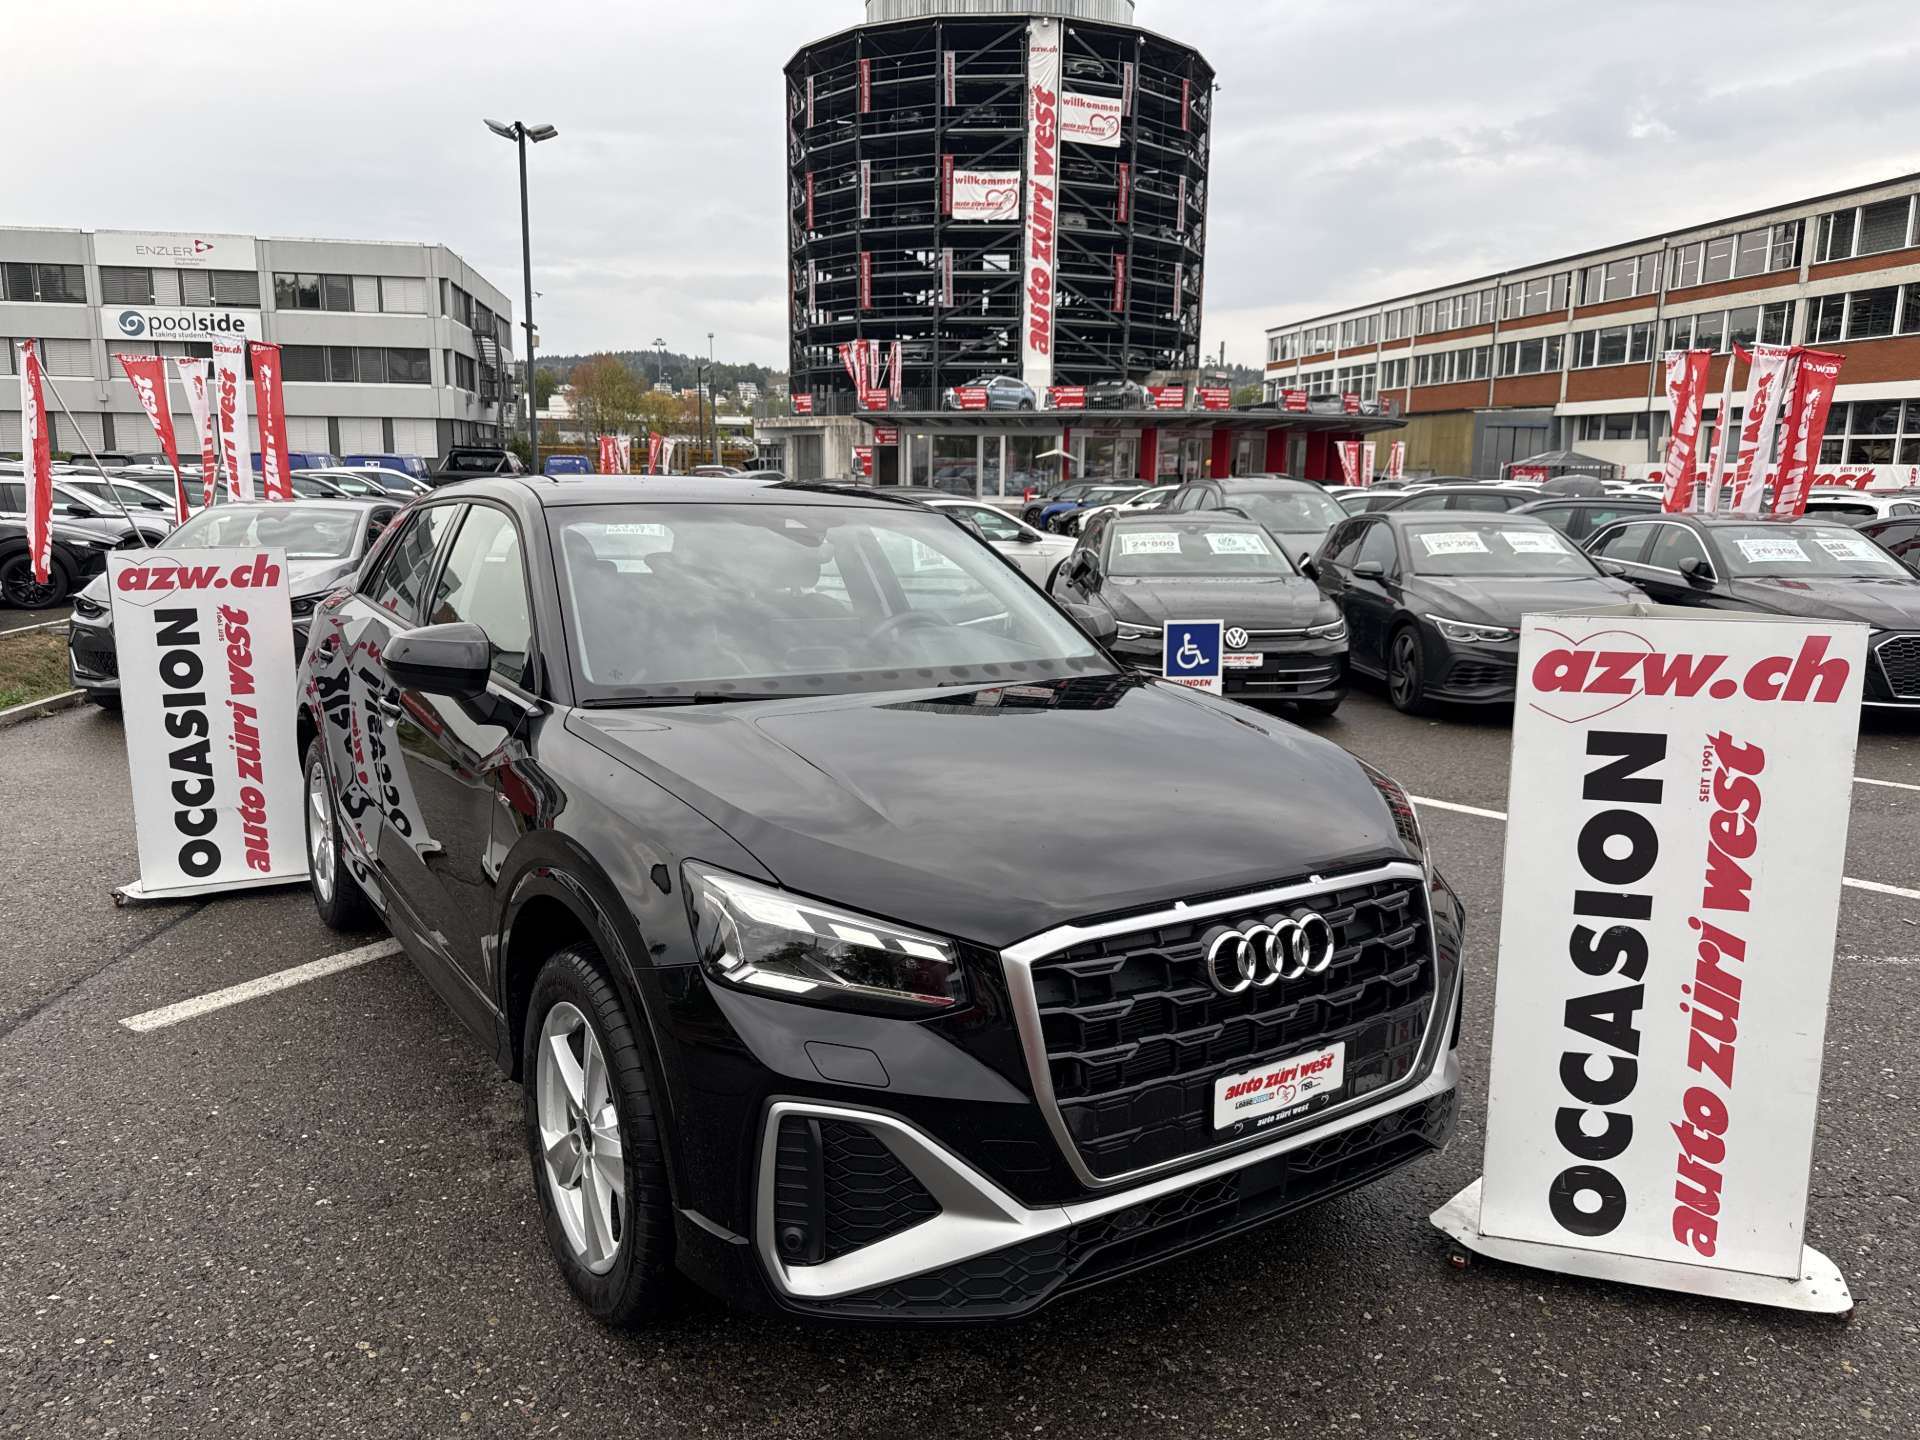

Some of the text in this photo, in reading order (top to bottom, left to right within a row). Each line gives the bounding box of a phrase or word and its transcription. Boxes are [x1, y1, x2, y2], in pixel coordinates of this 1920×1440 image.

[1062, 96, 1120, 112] willkommen
[955, 175, 1018, 185] willkommen
[1027, 84, 1056, 355] auto züri west
[136, 245, 193, 256] ENZLER
[149, 312, 246, 337] poolside
[117, 554, 281, 592] azw.ch
[1173, 679, 1213, 687] UNDEN
[1531, 636, 1851, 704] azw.ch
[154, 608, 222, 878] OCCASION
[217, 604, 271, 873] auto züri west
[1699, 745, 1714, 802] SEIT 1991
[1548, 730, 1668, 1237] OCCASION
[1669, 730, 1766, 1257] auto züri west
[1225, 1077, 1264, 1101] auto
[1264, 1063, 1300, 1089] züri
[1300, 1053, 1335, 1077] west
[1257, 1115, 1275, 1127] auto
[1293, 1103, 1310, 1115] west
